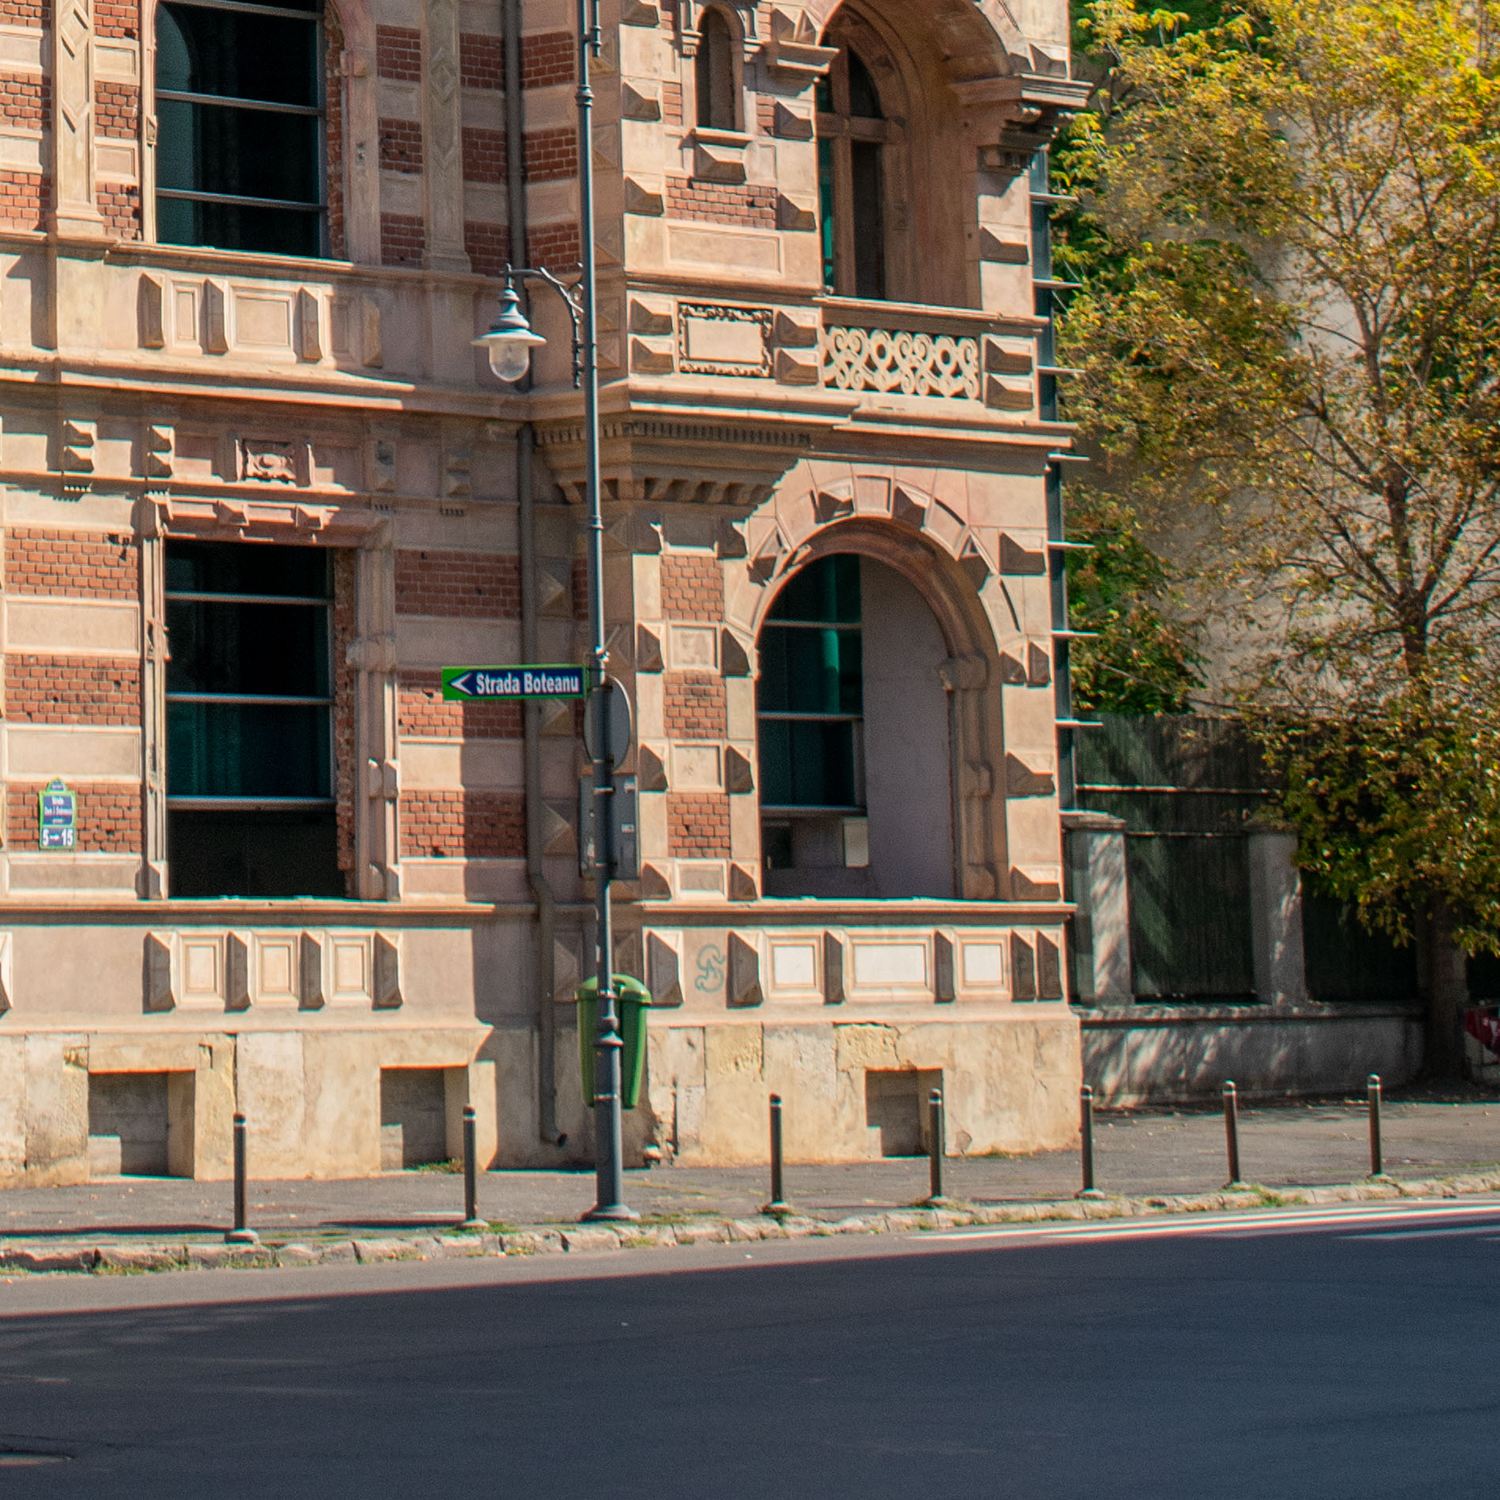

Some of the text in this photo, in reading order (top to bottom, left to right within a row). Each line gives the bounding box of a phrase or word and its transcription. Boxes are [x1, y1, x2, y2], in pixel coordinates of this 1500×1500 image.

[476, 671, 579, 695] Strada Boteanu
[42, 827, 73, 846] 5 15
